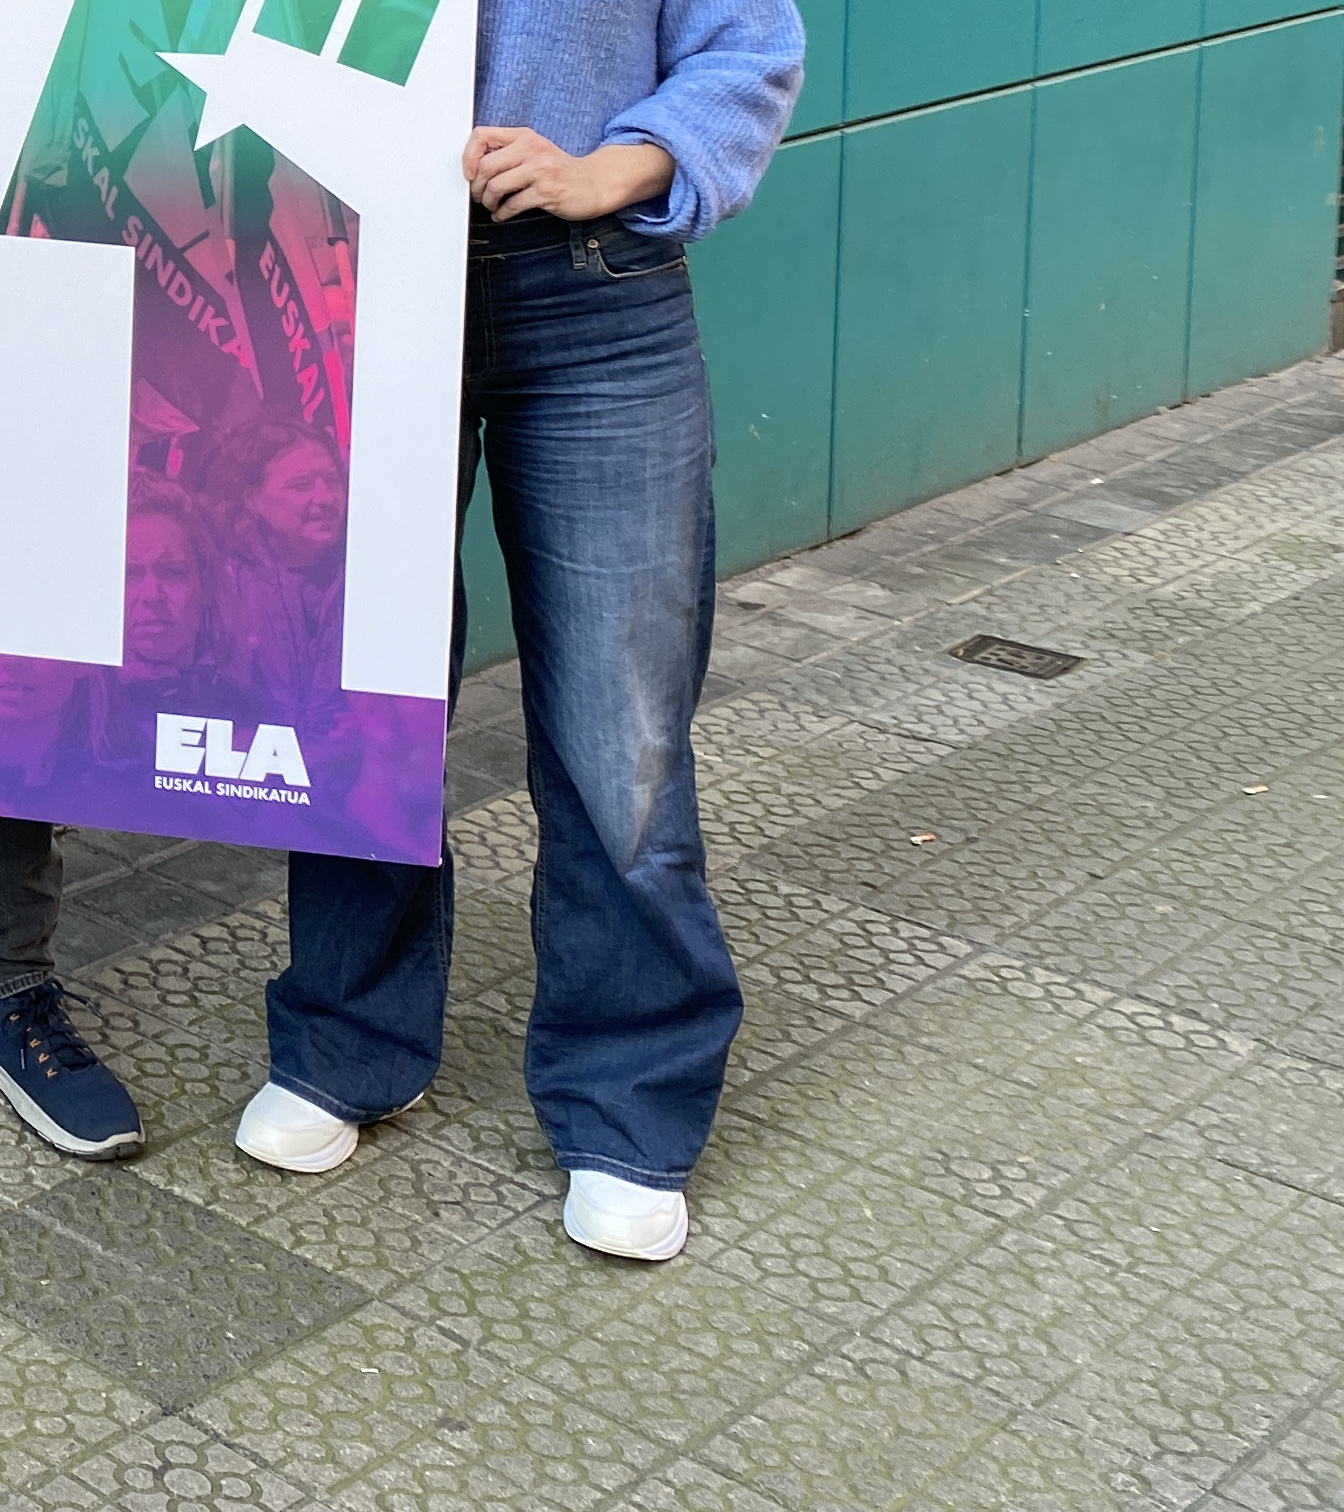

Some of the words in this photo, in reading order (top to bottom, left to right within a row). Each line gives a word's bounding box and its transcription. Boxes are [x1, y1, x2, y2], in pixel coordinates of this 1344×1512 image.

[72, 117, 118, 220] SKAL
[121, 215, 254, 369] SINDIKA
[259, 240, 325, 423] EUSKAL
[154, 775, 212, 795] EUSKAL
[216, 782, 311, 807] SINDIKATUA
[155, 712, 312, 788] ELA
